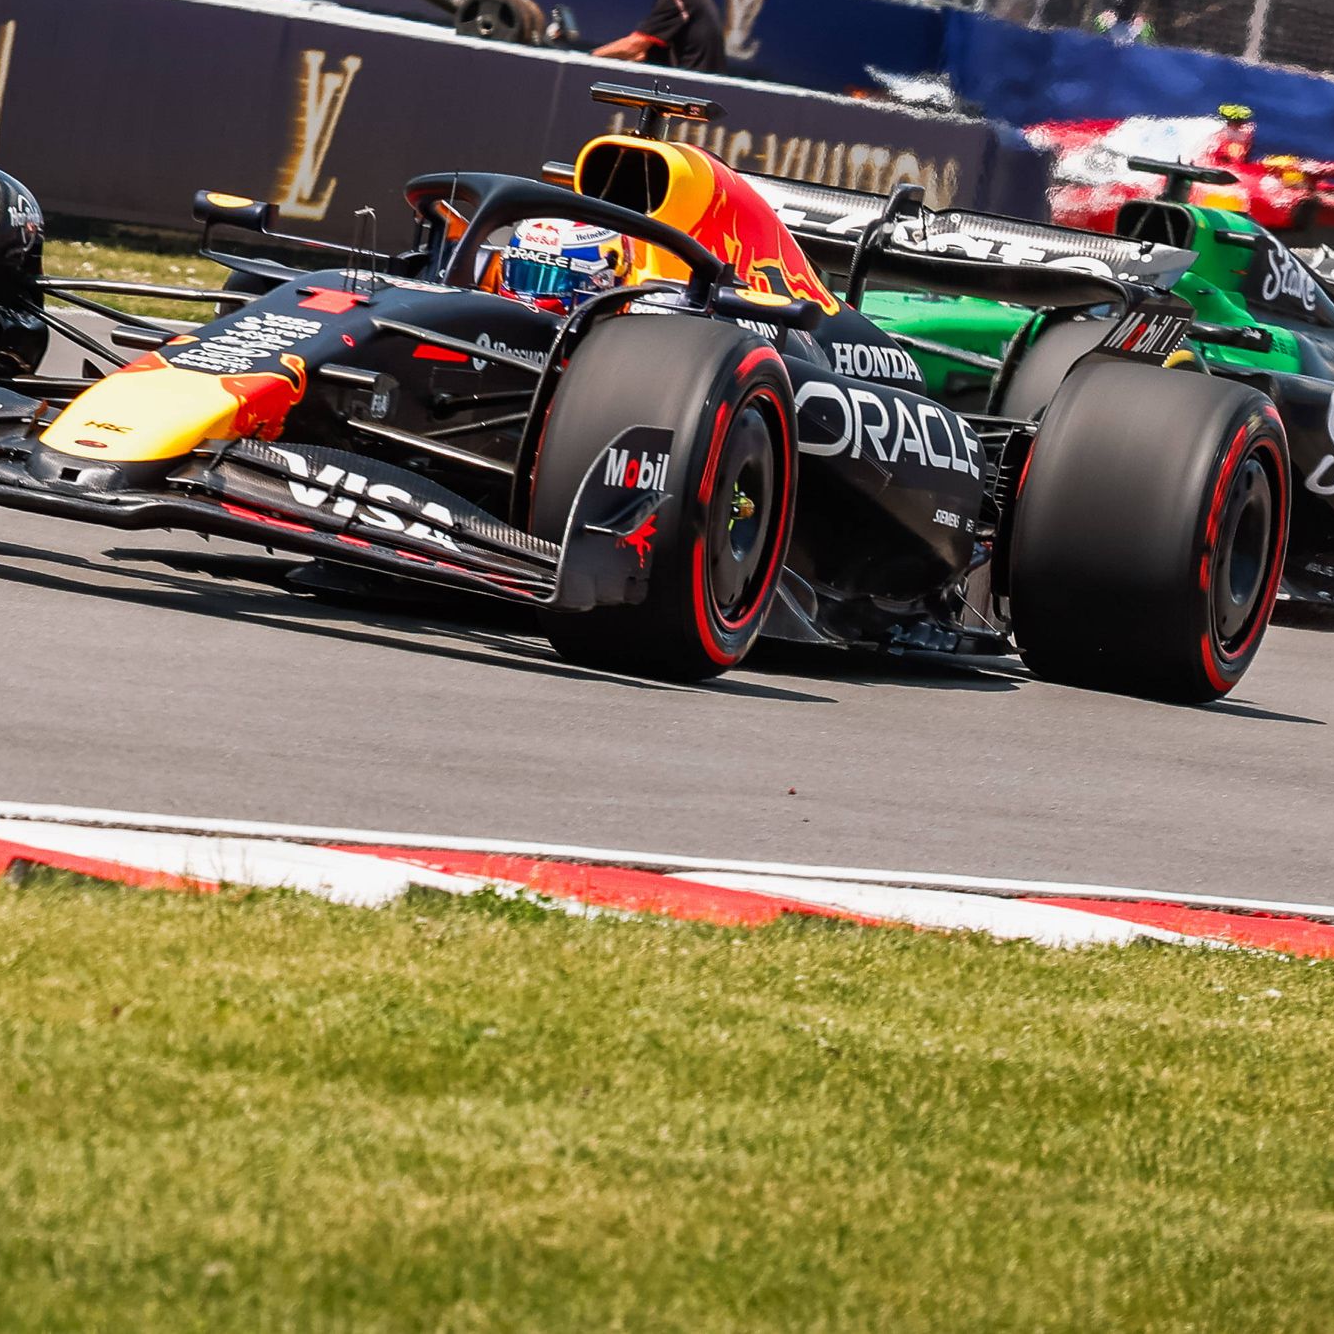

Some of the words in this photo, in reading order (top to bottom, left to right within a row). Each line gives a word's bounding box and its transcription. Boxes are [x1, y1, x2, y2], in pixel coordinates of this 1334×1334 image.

[506, 246, 570, 268] ORACLE
[1262, 234, 1317, 312] Stake
[1104, 311, 1174, 354] Mobil
[832, 342, 923, 383] HONDA
[796, 381, 980, 480] ORACLE
[604, 447, 670, 492] Mobil
[269, 446, 463, 553] VISA
